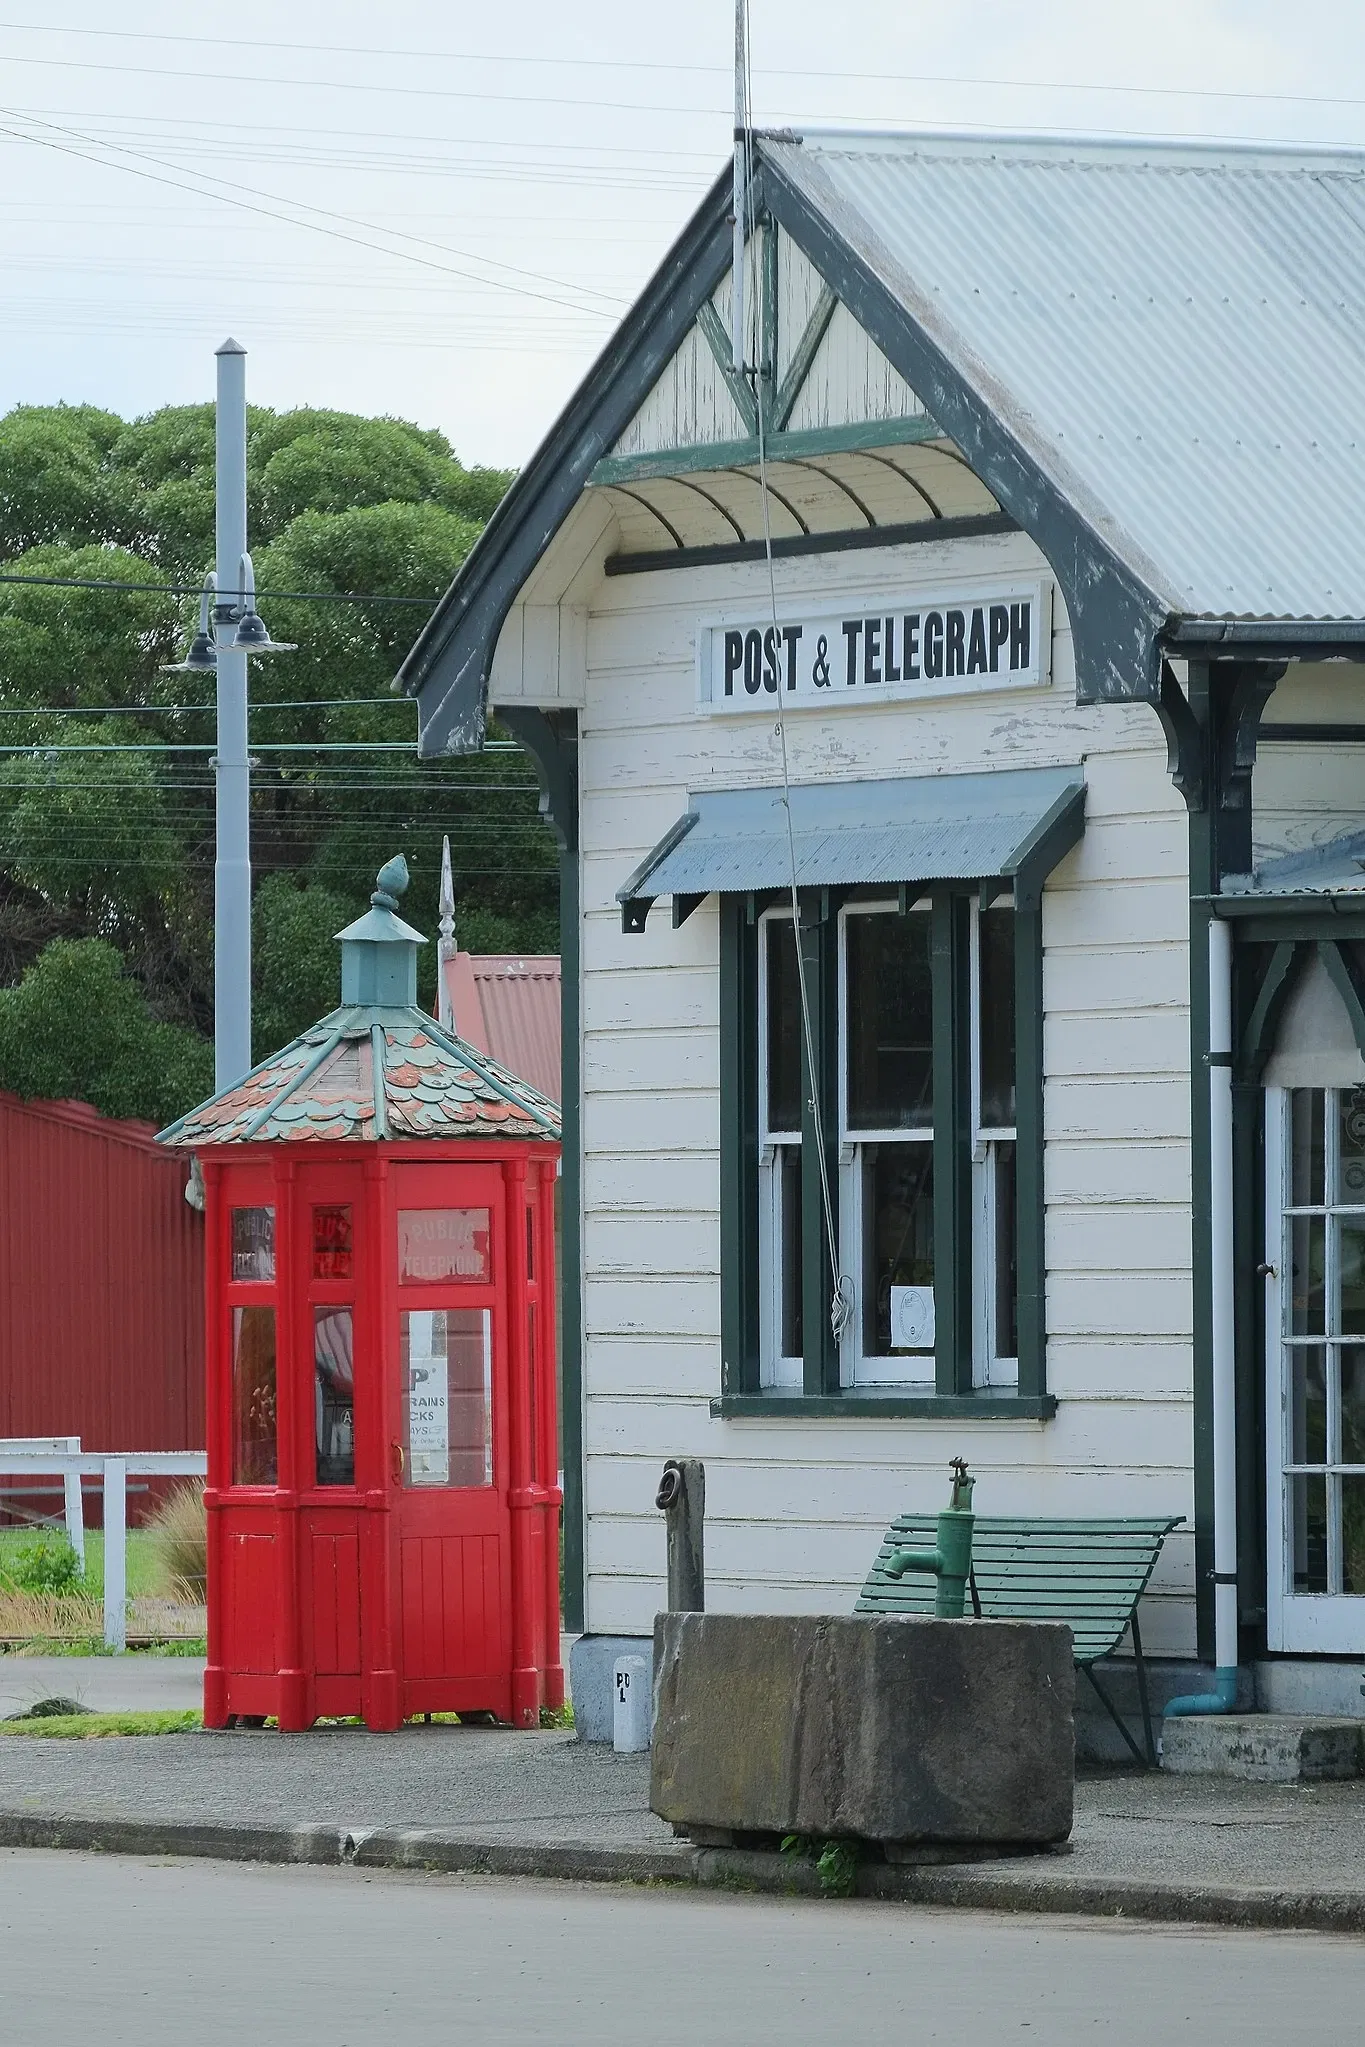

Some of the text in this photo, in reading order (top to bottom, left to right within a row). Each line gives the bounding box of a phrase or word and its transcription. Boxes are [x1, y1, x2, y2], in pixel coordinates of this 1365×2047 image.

[724, 602, 1031, 696] POST & TELEGRAPH
[411, 1219, 475, 1243] PUBLIC
